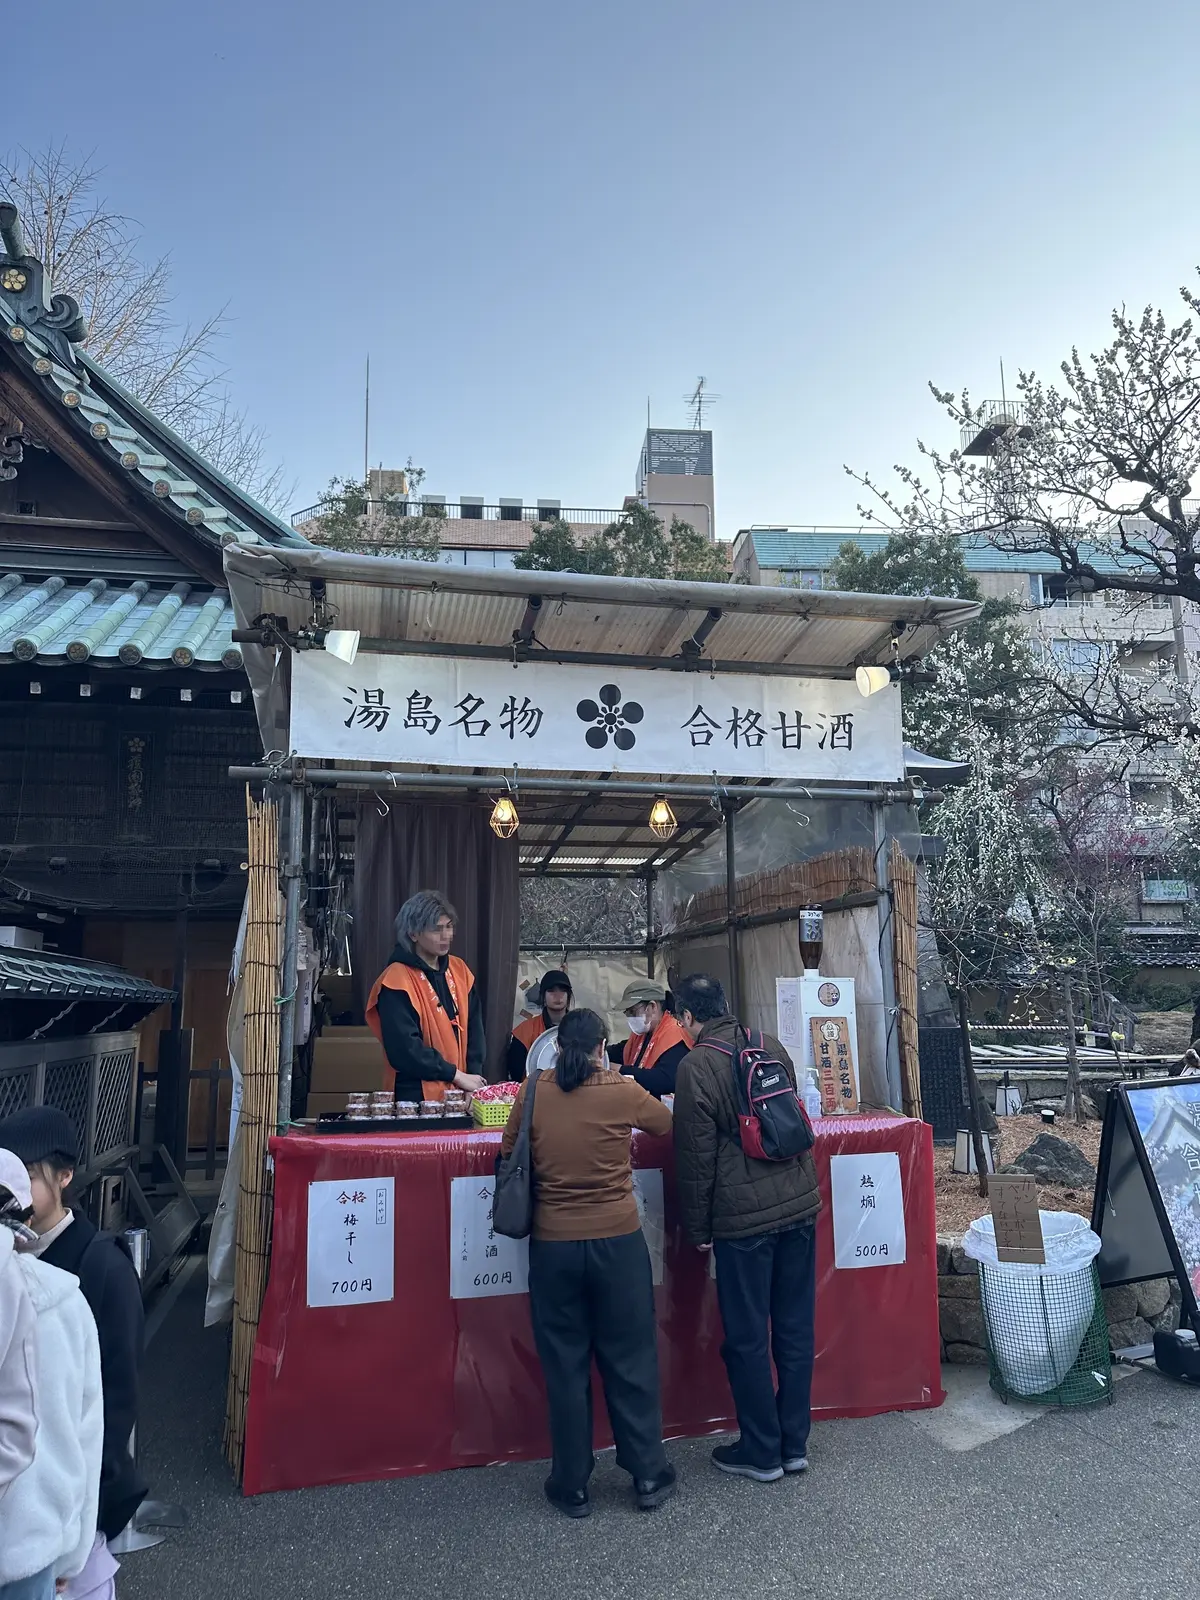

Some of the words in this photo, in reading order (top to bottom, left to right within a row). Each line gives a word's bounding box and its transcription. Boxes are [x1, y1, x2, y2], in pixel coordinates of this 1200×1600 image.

[343, 687, 544, 740] 湯島名物
[681, 704, 854, 752] 合格甘酒
[837, 1042, 852, 1098] 湯島名物
[336, 1191, 367, 1205] 合格
[860, 1174, 876, 1209] 熱燗
[344, 1213, 359, 1264] 梅干し
[855, 1243, 889, 1257] 500円
[332, 1278, 372, 1294] 700円
[473, 1271, 512, 1286] 600円
